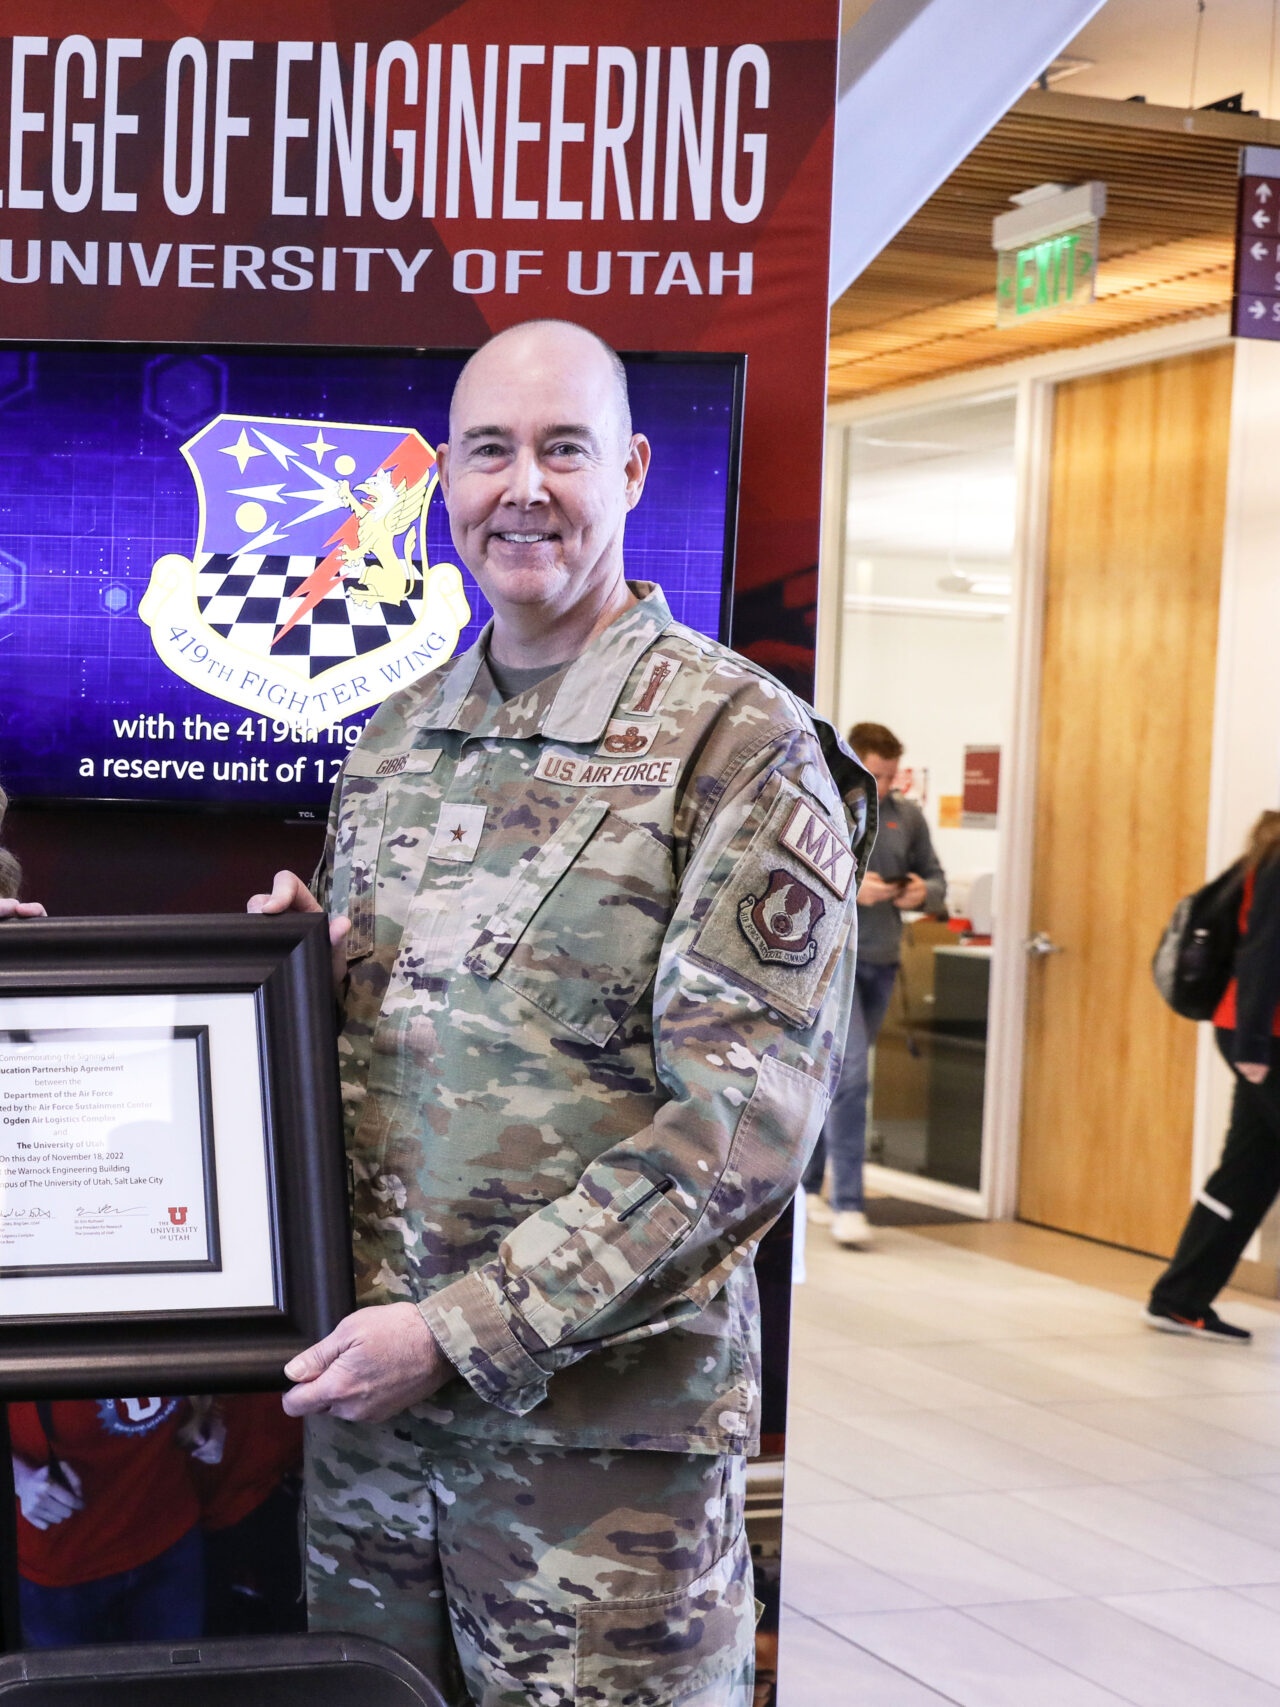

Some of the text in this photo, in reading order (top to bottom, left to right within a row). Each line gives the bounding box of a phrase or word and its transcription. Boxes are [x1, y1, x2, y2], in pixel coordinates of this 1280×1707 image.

[163, 36, 254, 217] OF
[271, 40, 771, 224] ENGINEERING
[452, 247, 544, 296] OF
[567, 249, 753, 297] UTAH
[1015, 235, 1081, 315] EXIT
[239, 669, 371, 714] FIGHTER
[379, 631, 447, 684] WING
[113, 713, 370, 751] with the 419th fig
[79, 757, 95, 778] a
[102, 757, 205, 781] reserve
[212, 757, 269, 782] unit
[275, 757, 308, 783] of
[578, 763, 612, 784] AIR
[617, 761, 672, 783] FORCE
[795, 814, 847, 884] MX
[32, 1065, 79, 1075] Partnership
[80, 1064, 124, 1073] Agreement
[34, 1078, 81, 1086] between the
[3, 1091, 52, 1100] Department
[53, 1090, 62, 1098] of
[91, 1089, 113, 1097] Force
[13, 1104, 23, 1113] by
[38, 1103, 51, 1111] Air
[52, 1103, 74, 1111] Force
[75, 1102, 125, 1110] Sustainment
[3, 1116, 30, 1126] Ogden
[45, 1115, 79, 1125] Logistics
[33, 1141, 74, 1150] University
[75, 1140, 84, 1148] of
[85, 1140, 105, 1148] Utah
[11, 1154, 26, 1162] this
[27, 1154, 41, 1164] day
[42, 1154, 50, 1162] of
[51, 1153, 91, 1161] November
[105, 1152, 124, 1160] 2022
[4, 1167, 17, 1176] the
[17, 1167, 51, 1175] Warnock
[52, 1165, 98, 1176] Engineering
[99, 1164, 130, 1173] Building
[19, 1180, 27, 1188] of
[28, 1179, 43, 1187] The
[44, 1178, 83, 1188] University
[83, 1178, 91, 1186] of
[92, 1177, 113, 1186] Utah,
[114, 1177, 128, 1185] Salt
[129, 1176, 147, 1185] Lake
[148, 1176, 163, 1186] City
[167, 1206, 188, 1225] U
[150, 1225, 199, 1235] UNIVERSITY
[168, 1234, 190, 1242] UTAH
